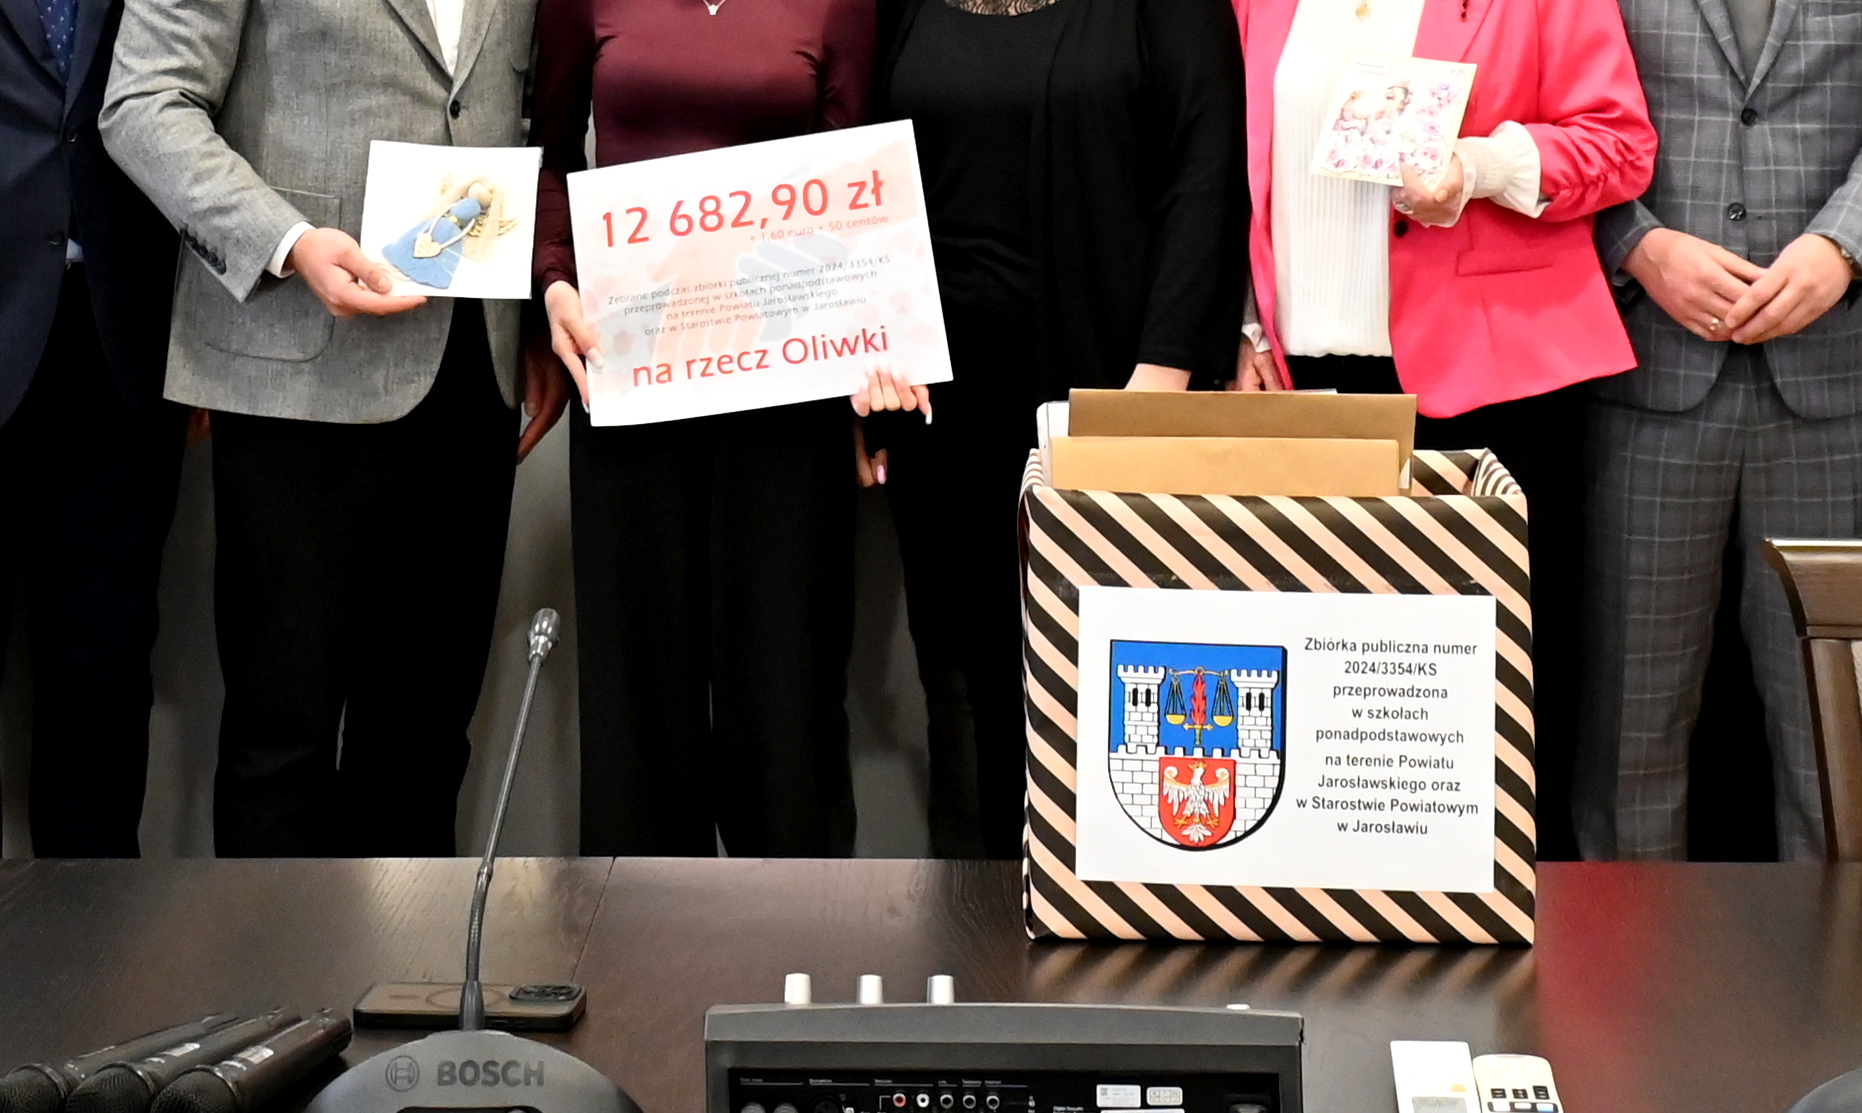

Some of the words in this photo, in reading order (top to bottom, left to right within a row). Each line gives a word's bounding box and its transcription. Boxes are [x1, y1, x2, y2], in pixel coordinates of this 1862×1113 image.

[603, 207, 650, 248] 12
[669, 178, 829, 237] 682,90
[847, 170, 884, 211] zł
[788, 226, 814, 238] euro
[828, 220, 843, 232] 50
[846, 215, 889, 230] centów
[608, 291, 649, 306] Zebrane
[651, 285, 691, 301] podczas
[729, 272, 780, 288] publicznej
[783, 267, 815, 279] numer
[624, 294, 710, 316] przeprowadzonej
[712, 294, 722, 302] w
[769, 270, 878, 295] ponadpodstawowych
[666, 311, 679, 320] na
[682, 306, 716, 320] terenie
[719, 300, 760, 312] Powiatu
[644, 326, 666, 336] oraz
[669, 324, 678, 332] w
[680, 315, 732, 331] Starostwie
[734, 305, 799, 322] Powiatowym
[633, 362, 673, 387] na
[686, 348, 770, 380] rzecz
[781, 325, 889, 365] Oliwki
[1304, 636, 1357, 652] Zbiórka
[1361, 639, 1429, 656] publiczna
[1433, 643, 1478, 656] numer
[1343, 660, 1438, 677] 2024/3354/KS
[1333, 685, 1449, 700] przeprowadzona
[1351, 707, 1363, 719] w
[1316, 727, 1465, 747] ponadpodstawowych
[1325, 755, 1342, 766] na
[1346, 753, 1394, 768] terenie
[1398, 754, 1455, 770] Powiatu
[1317, 774, 1427, 794] Jarosławskiego
[1431, 779, 1462, 792] oraz
[1296, 798, 1307, 809] w
[1311, 795, 1386, 812] Starostwie
[1390, 798, 1479, 818] Powiatowym
[1337, 821, 1348, 832] w
[1352, 819, 1429, 835] Jarosławiu
[438, 1059, 545, 1087] BOSCH
